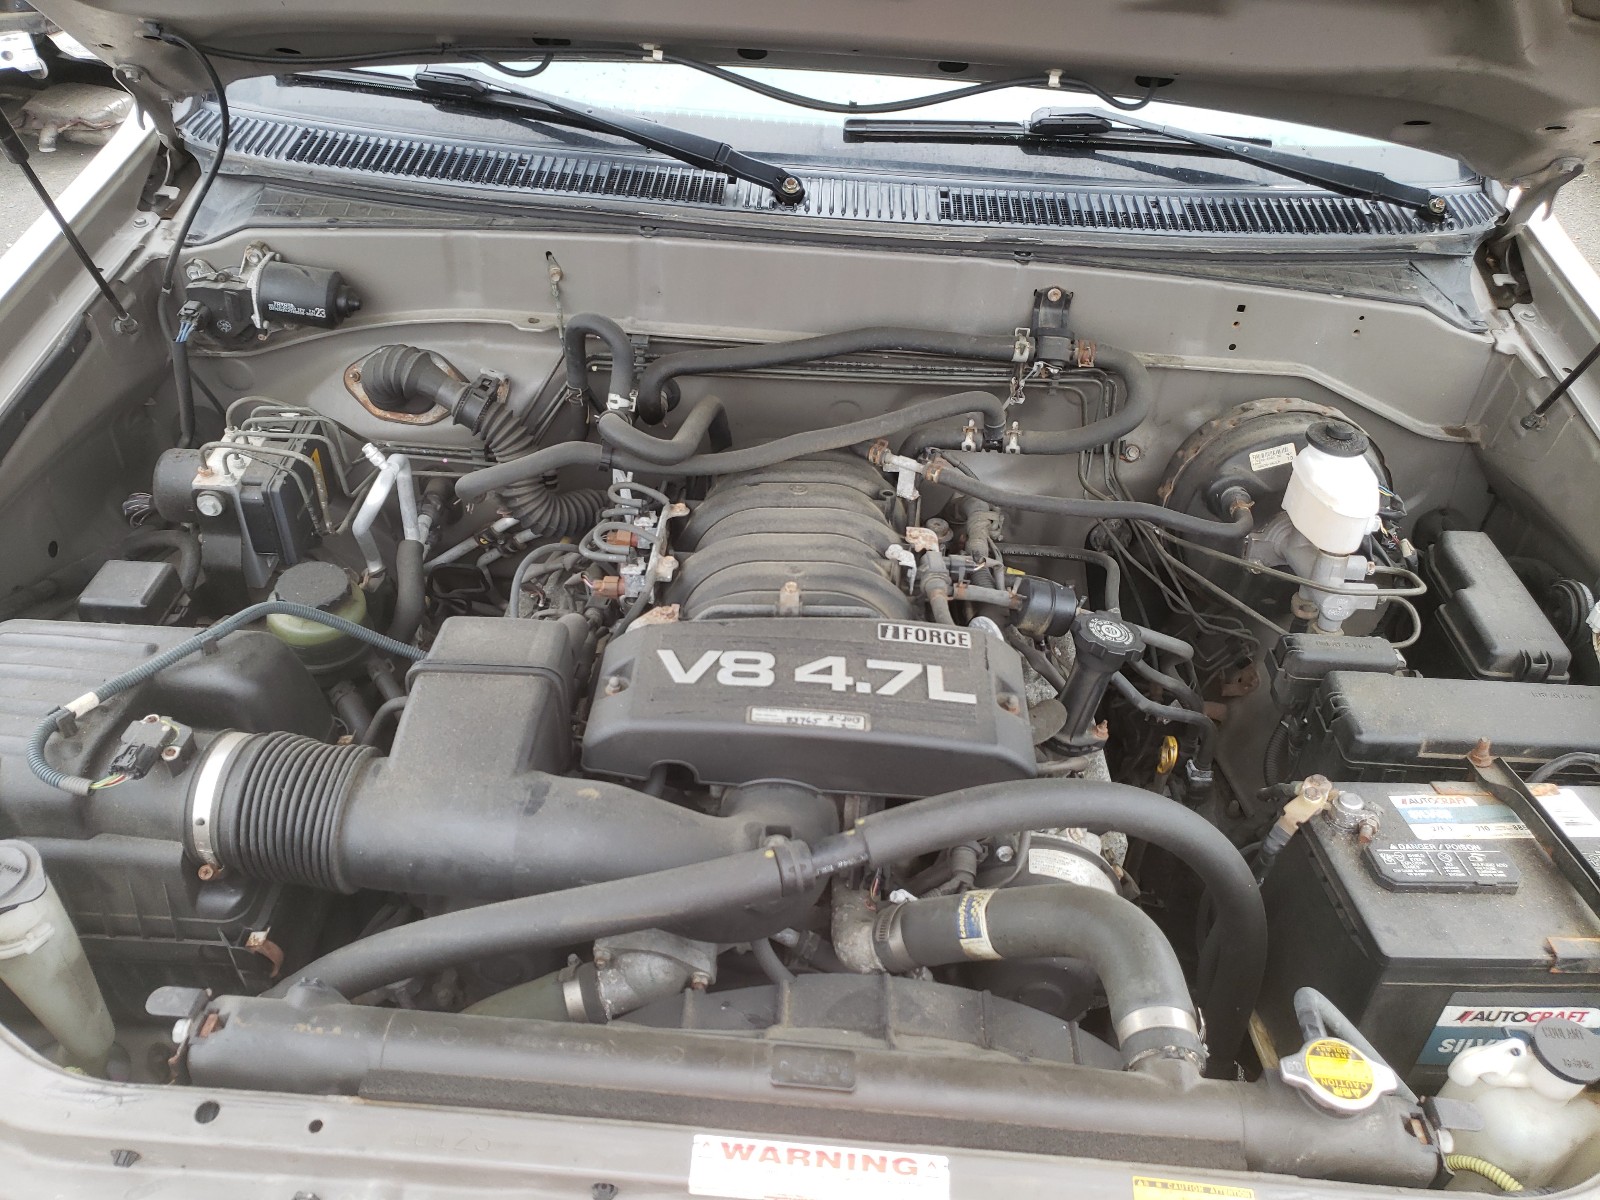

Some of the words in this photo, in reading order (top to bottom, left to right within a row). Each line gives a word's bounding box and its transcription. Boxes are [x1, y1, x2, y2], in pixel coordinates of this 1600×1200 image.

[657, 649, 775, 686] V8
[794, 655, 977, 704] 4.7L
[1320, 1078, 1368, 1090] CAUTION
[721, 1142, 918, 1176] WARNING
